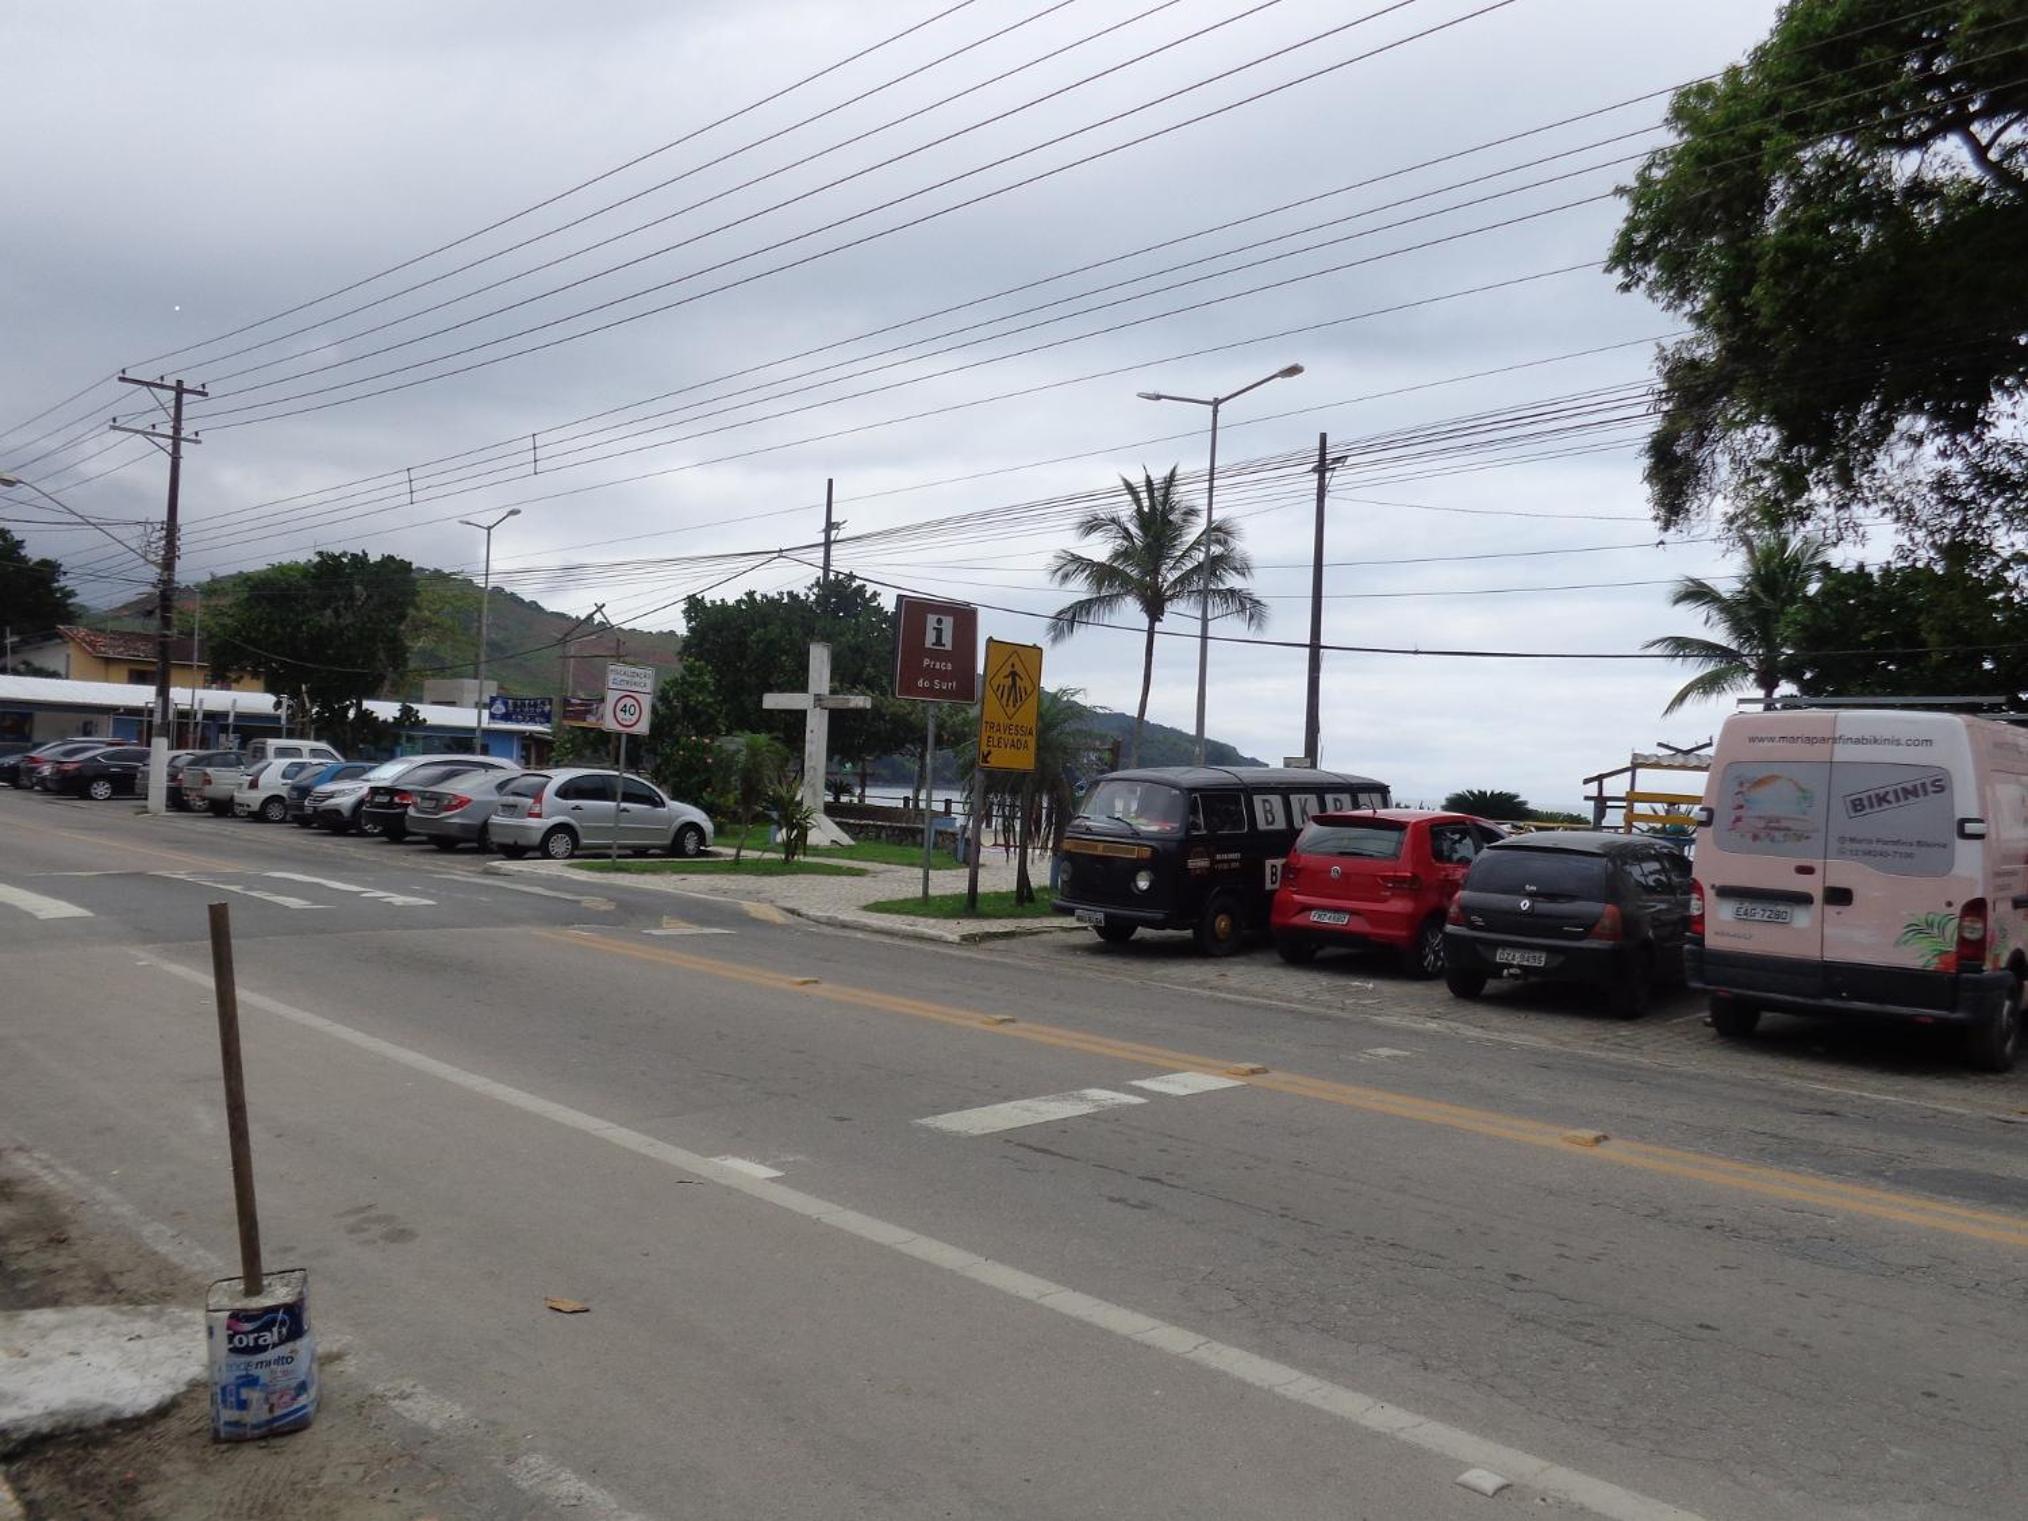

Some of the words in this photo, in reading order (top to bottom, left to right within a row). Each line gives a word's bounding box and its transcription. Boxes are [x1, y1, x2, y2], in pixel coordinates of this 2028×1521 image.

[917, 678, 930, 688] do
[934, 680, 956, 690] Surf
[620, 703, 636, 716] 40
[984, 721, 1033, 737] TRAVESSIA
[987, 735, 1029, 751] ELEVADA
[1850, 778, 1946, 814] BIKINIS
[226, 1326, 280, 1350] Coral
